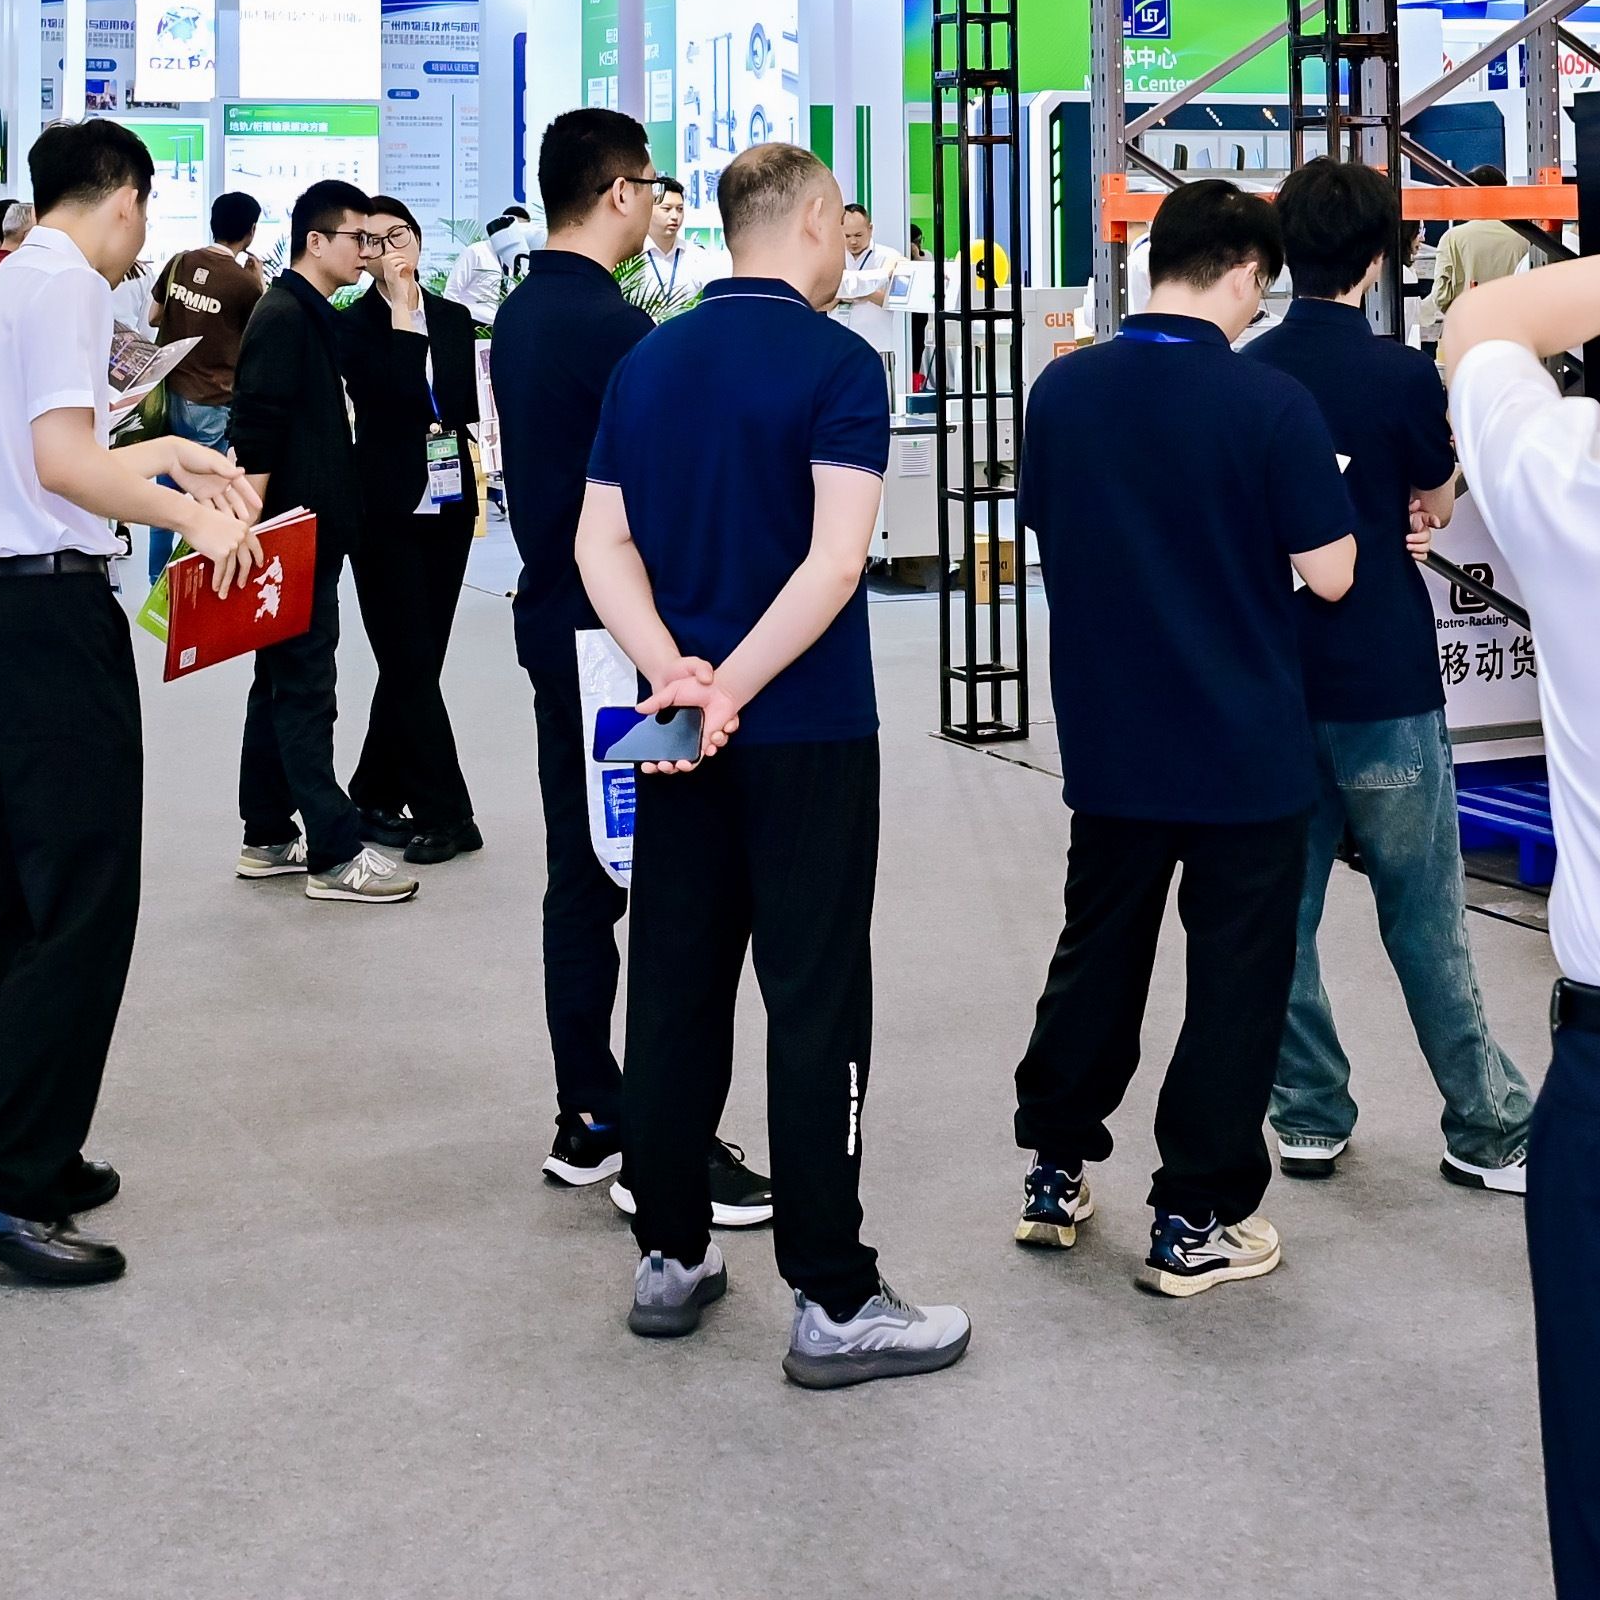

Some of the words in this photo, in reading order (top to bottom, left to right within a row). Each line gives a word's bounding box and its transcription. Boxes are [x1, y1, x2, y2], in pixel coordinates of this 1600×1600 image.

[1141, 8, 1159, 23] LET
[1123, 45, 1178, 70] 体中心
[1138, 75, 1193, 92] Center
[169, 282, 222, 314] FRMND
[1436, 614, 1509, 630] Botro-Racking
[1440, 635, 1538, 686] 移动货
